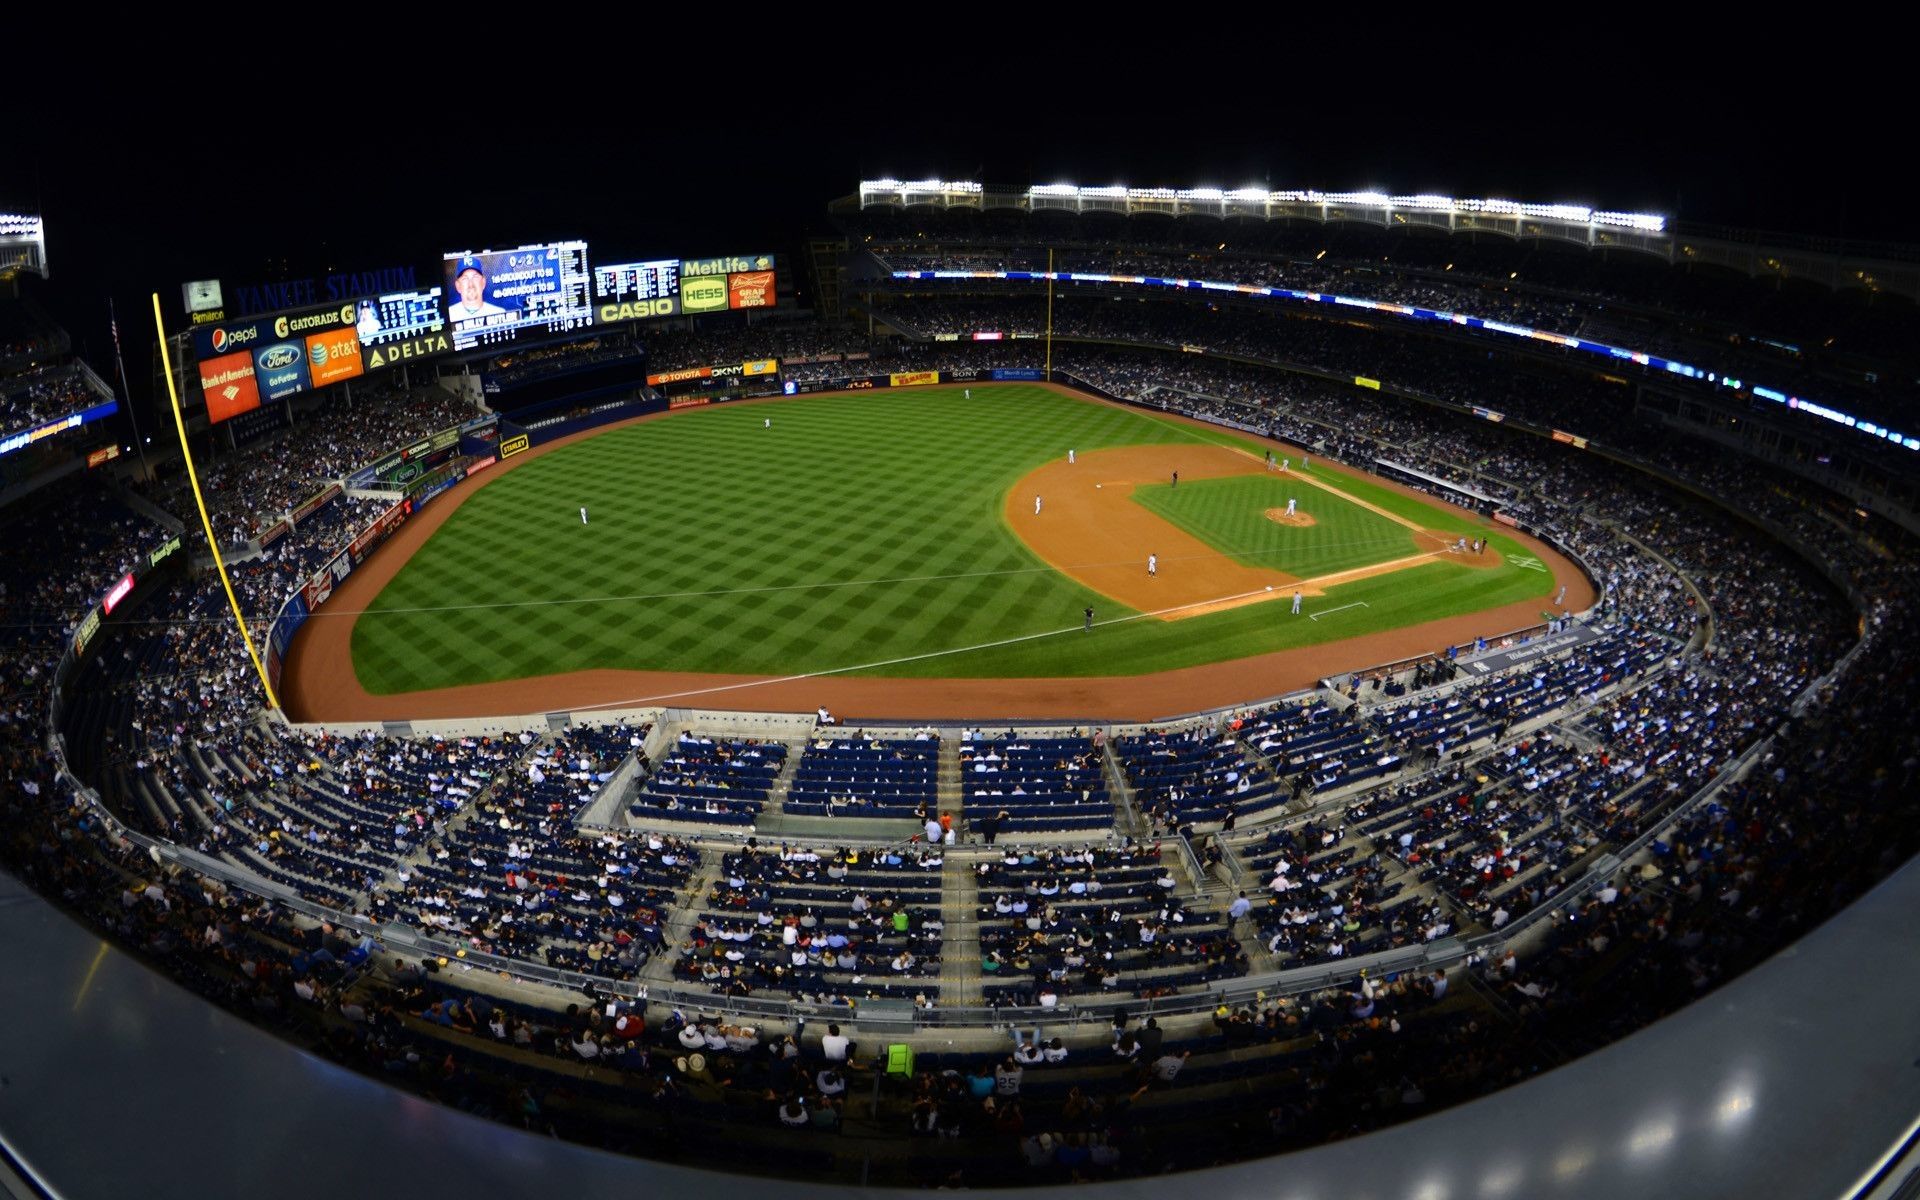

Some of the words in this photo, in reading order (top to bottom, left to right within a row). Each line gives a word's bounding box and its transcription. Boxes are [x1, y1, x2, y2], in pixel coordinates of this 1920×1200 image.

[684, 257, 749, 277] MetLife
[236, 280, 317, 315] YANKEE
[325, 266, 416, 301] STADIUM
[685, 287, 723, 300] HESS
[739, 288, 765, 297] GRAB
[601, 298, 673, 322] CASIO
[739, 297, 765, 307] BUDS
[290, 312, 339, 331] GATORADE
[228, 325, 257, 347] pepsi
[267, 348, 293, 368] Ford
[331, 339, 357, 359] at&t
[388, 336, 448, 361] DELTA
[201, 373, 220, 390] Bank
[219, 370, 227, 384] of
[226, 366, 255, 382] America
[268, 377, 279, 387] Go
[278, 372, 298, 384] Further
[669, 370, 702, 381] TOYOTA
[711, 366, 743, 378] DKNY
[952, 370, 977, 378] SONY
[503, 439, 526, 452] STANLEY
[998, 1077, 1015, 1089] 25
